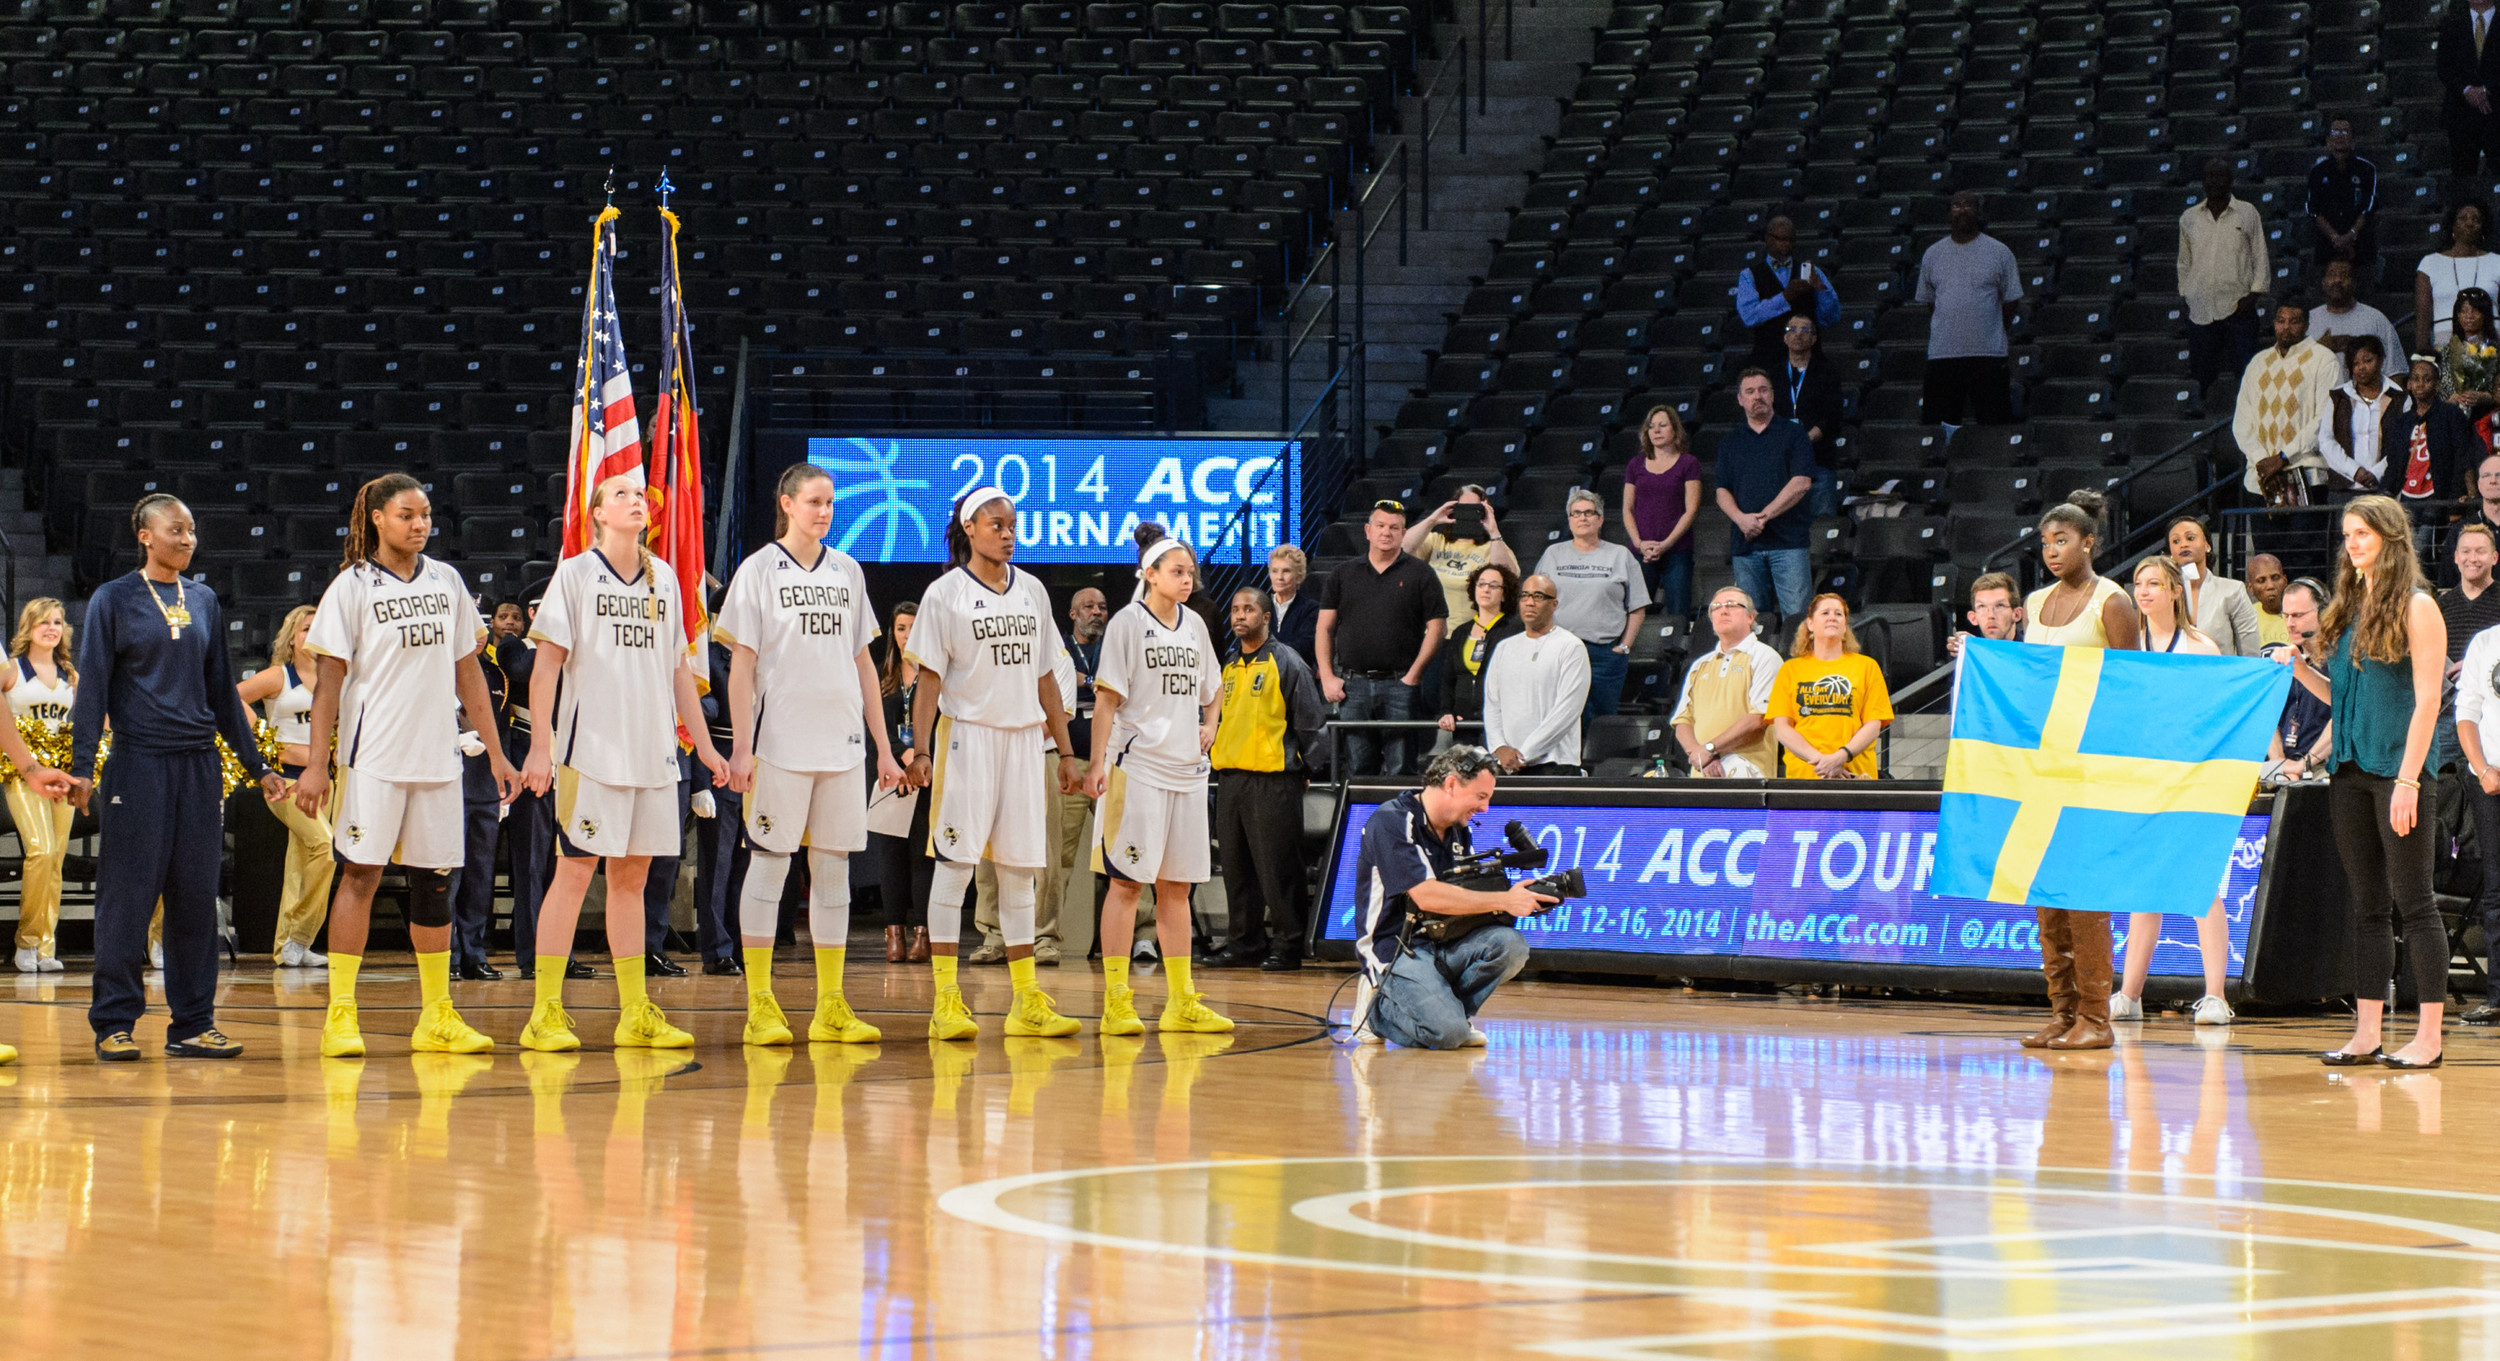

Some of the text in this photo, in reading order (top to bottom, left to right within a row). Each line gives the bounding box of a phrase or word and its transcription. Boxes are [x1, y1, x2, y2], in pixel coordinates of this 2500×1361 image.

[951, 453, 1283, 504] 2014 ACC
[1014, 510, 1282, 548] URNAMENT
[373, 593, 451, 624] GEORGIA
[596, 593, 666, 622] GEORGA
[779, 586, 850, 609] GEORGIA
[398, 622, 445, 649] TECH
[612, 623, 655, 649] TECH
[799, 612, 842, 636] TECH
[971, 614, 1038, 641] GEORGIA
[991, 642, 1031, 666] TECH
[1162, 673, 1197, 696] TECH
[1799, 684, 1829, 695] ALL DAY
[1803, 692, 1850, 706] EVERY DAY
[294, 710, 311, 724] TE
[1502, 823, 1939, 892] 014 ACC TOUR
[1580, 904, 1653, 940] 12-16,
[1660, 906, 1722, 938] 2014
[1745, 909, 1929, 946] theACC.com
